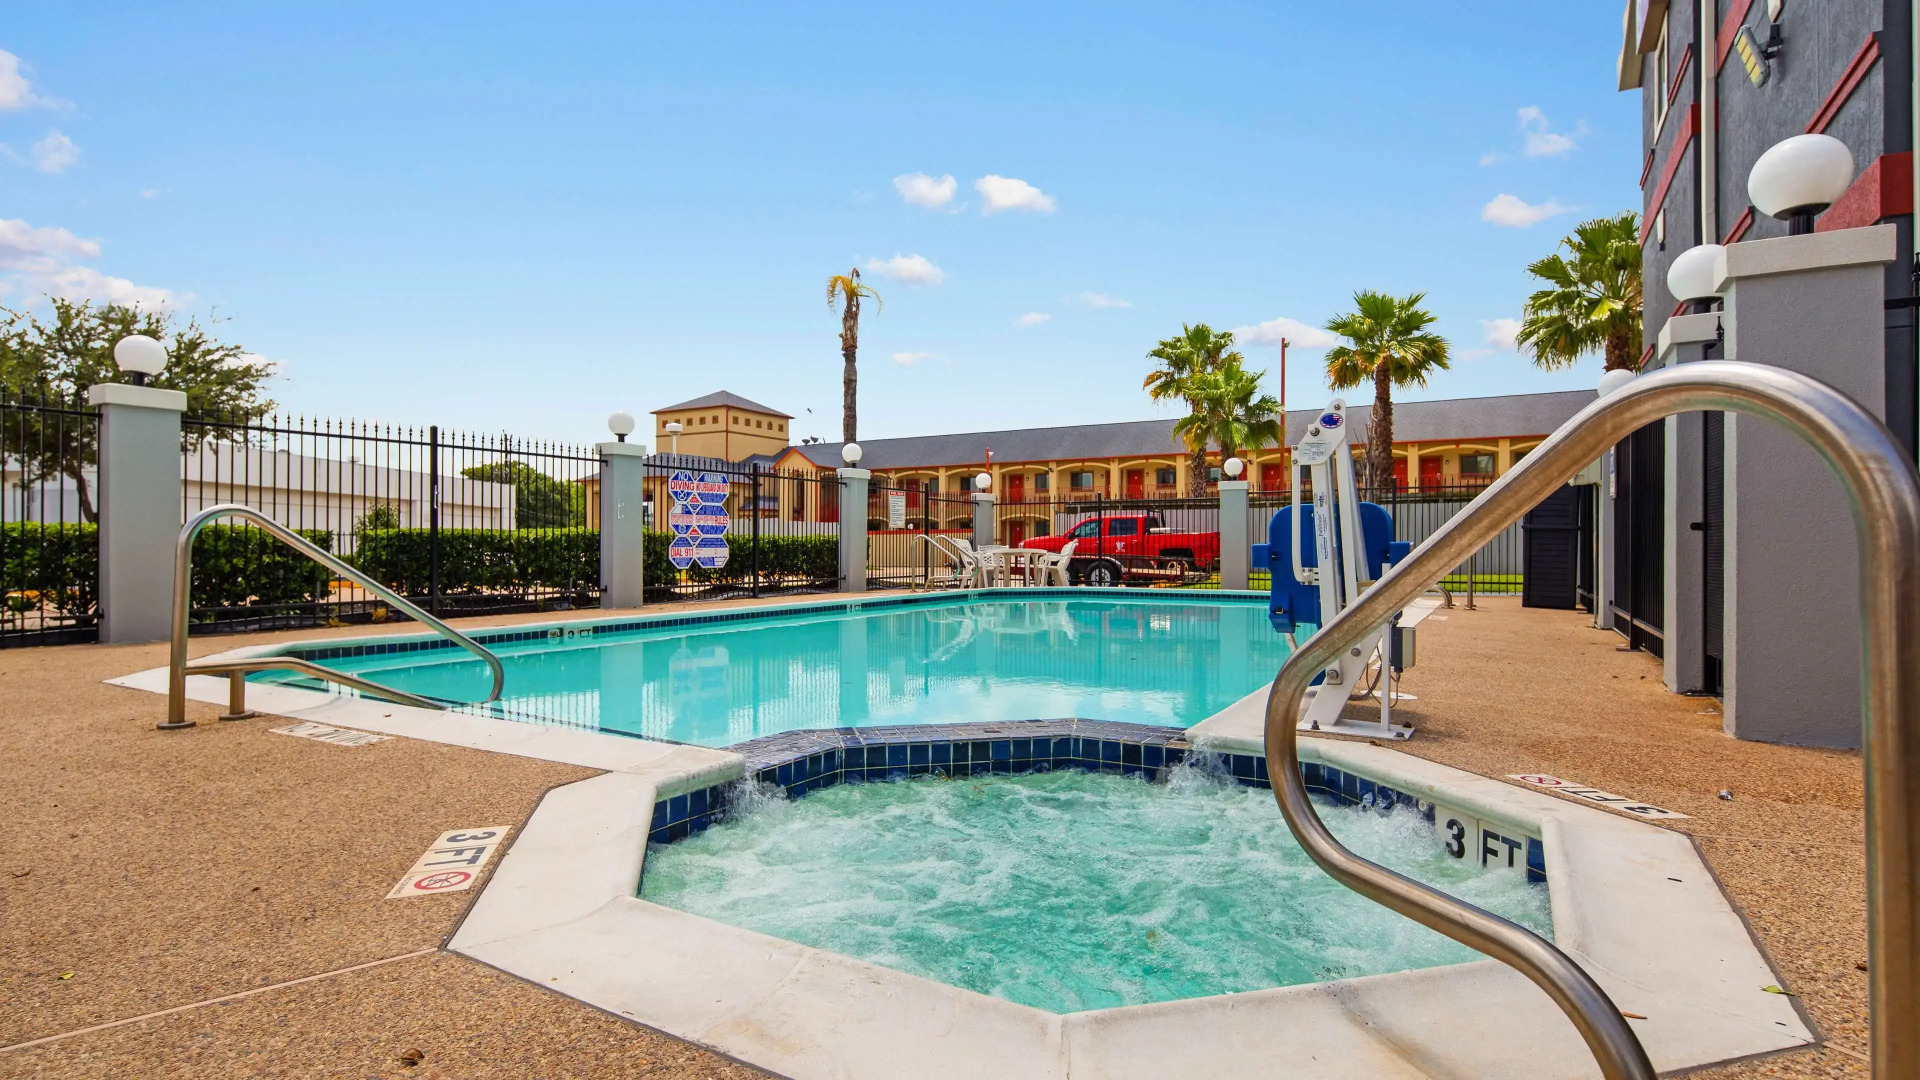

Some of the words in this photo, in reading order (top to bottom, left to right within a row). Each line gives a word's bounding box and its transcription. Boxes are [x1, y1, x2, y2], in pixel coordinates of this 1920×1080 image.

[679, 471, 689, 481] NO
[671, 481, 694, 491] DIVING
[671, 548, 683, 557] DIAL
[685, 548, 693, 557] 911
[1560, 788, 1629, 802] FT
[1623, 805, 1669, 815] 3
[446, 831, 497, 843] 3
[1445, 819, 1465, 859] 3
[1482, 828, 1522, 868] FT
[423, 846, 487, 867] FT
